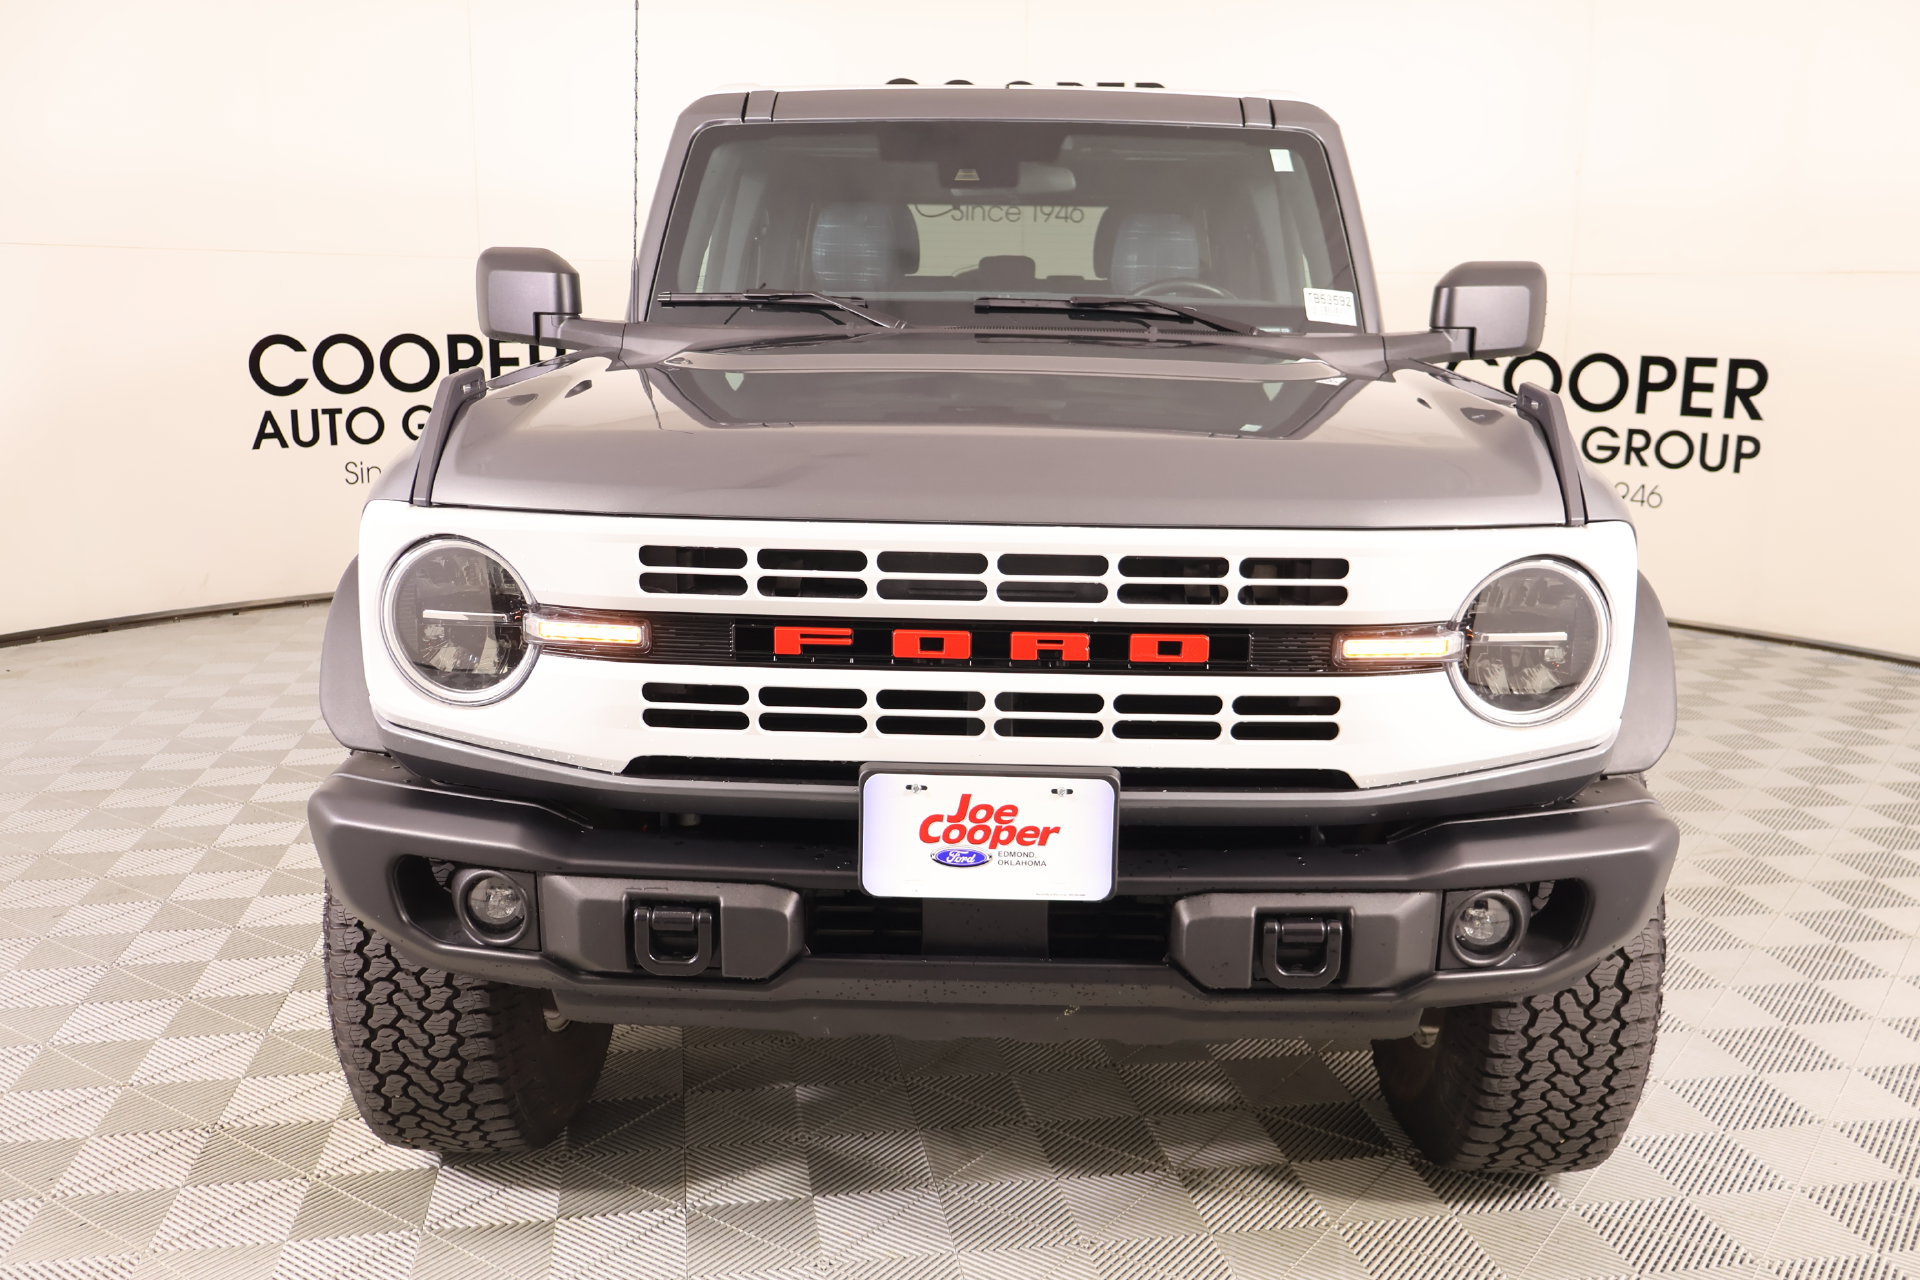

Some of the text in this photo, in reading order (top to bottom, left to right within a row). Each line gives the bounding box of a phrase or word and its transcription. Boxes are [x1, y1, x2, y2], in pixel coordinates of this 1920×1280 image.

[950, 204, 1085, 223] Since 1946
[1446, 350, 1769, 421] OOPER
[252, 406, 385, 450] AUTO
[1581, 426, 1761, 474] GROUP
[774, 626, 1210, 663] FORD
[946, 793, 1019, 825] Joe
[919, 814, 1061, 850] Cooper
[945, 850, 977, 864] Ford
[997, 859, 1047, 868] OKLAHOMA
